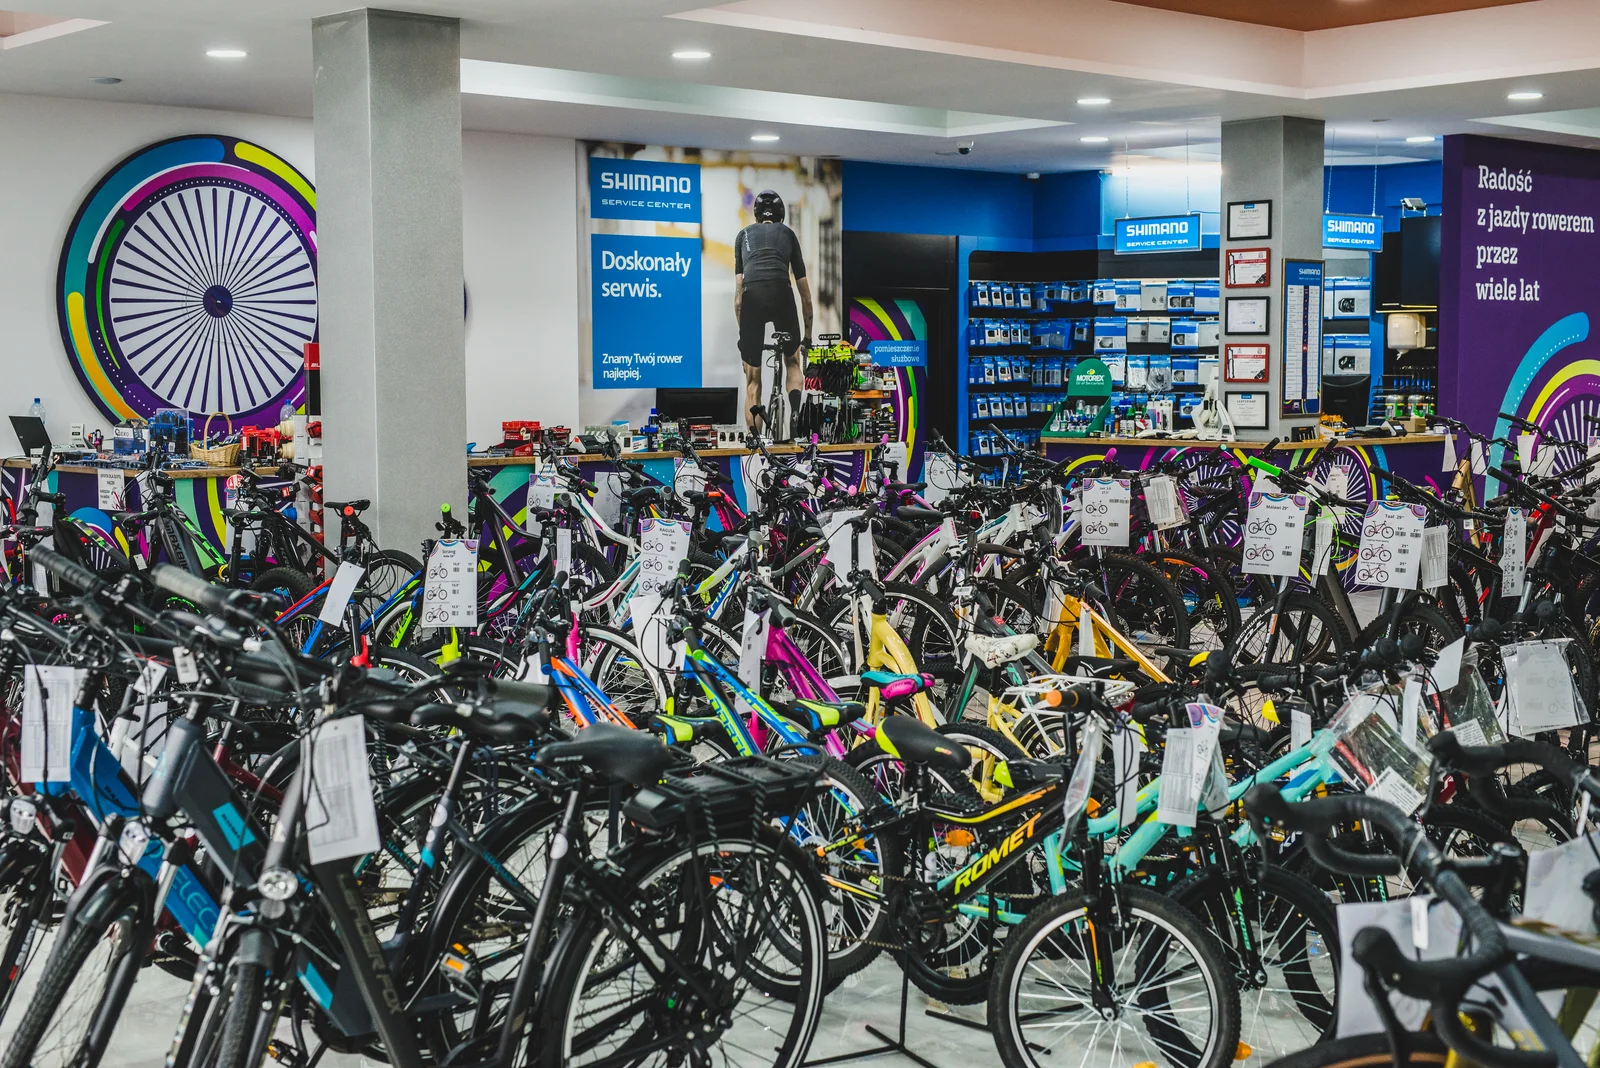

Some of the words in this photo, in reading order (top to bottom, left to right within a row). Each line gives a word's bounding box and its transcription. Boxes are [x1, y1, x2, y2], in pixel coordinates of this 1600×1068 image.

[601, 172, 691, 194] SHIMANO
[1478, 165, 1533, 193] Radość
[602, 199, 645, 207] SERVICE
[647, 201, 691, 209] CENTER
[1327, 219, 1375, 234] SHIMANO
[1477, 208, 1486, 226] z
[1488, 203, 1530, 235] jazdy
[1532, 212, 1595, 234] rowerem
[1126, 221, 1189, 237] SHIMANO
[602, 250, 691, 277] Doskonały
[1476, 245, 1518, 269] przez
[1298, 268, 1321, 276] SHIMANO
[601, 278, 662, 298] serwis.
[1476, 276, 1517, 301] wiele
[1519, 278, 1540, 301] lat
[874, 344, 920, 354] pomieszczenie
[602, 353, 633, 367] Znamy
[634, 352, 656, 366] Twój
[657, 355, 683, 364] rower
[891, 355, 920, 363] służbowe
[603, 367, 642, 381] najlepiej.
[1076, 374, 1105, 382] MOTOREX
[165, 524, 191, 572] MAXBIK
[954, 812, 1042, 895] ROMET
